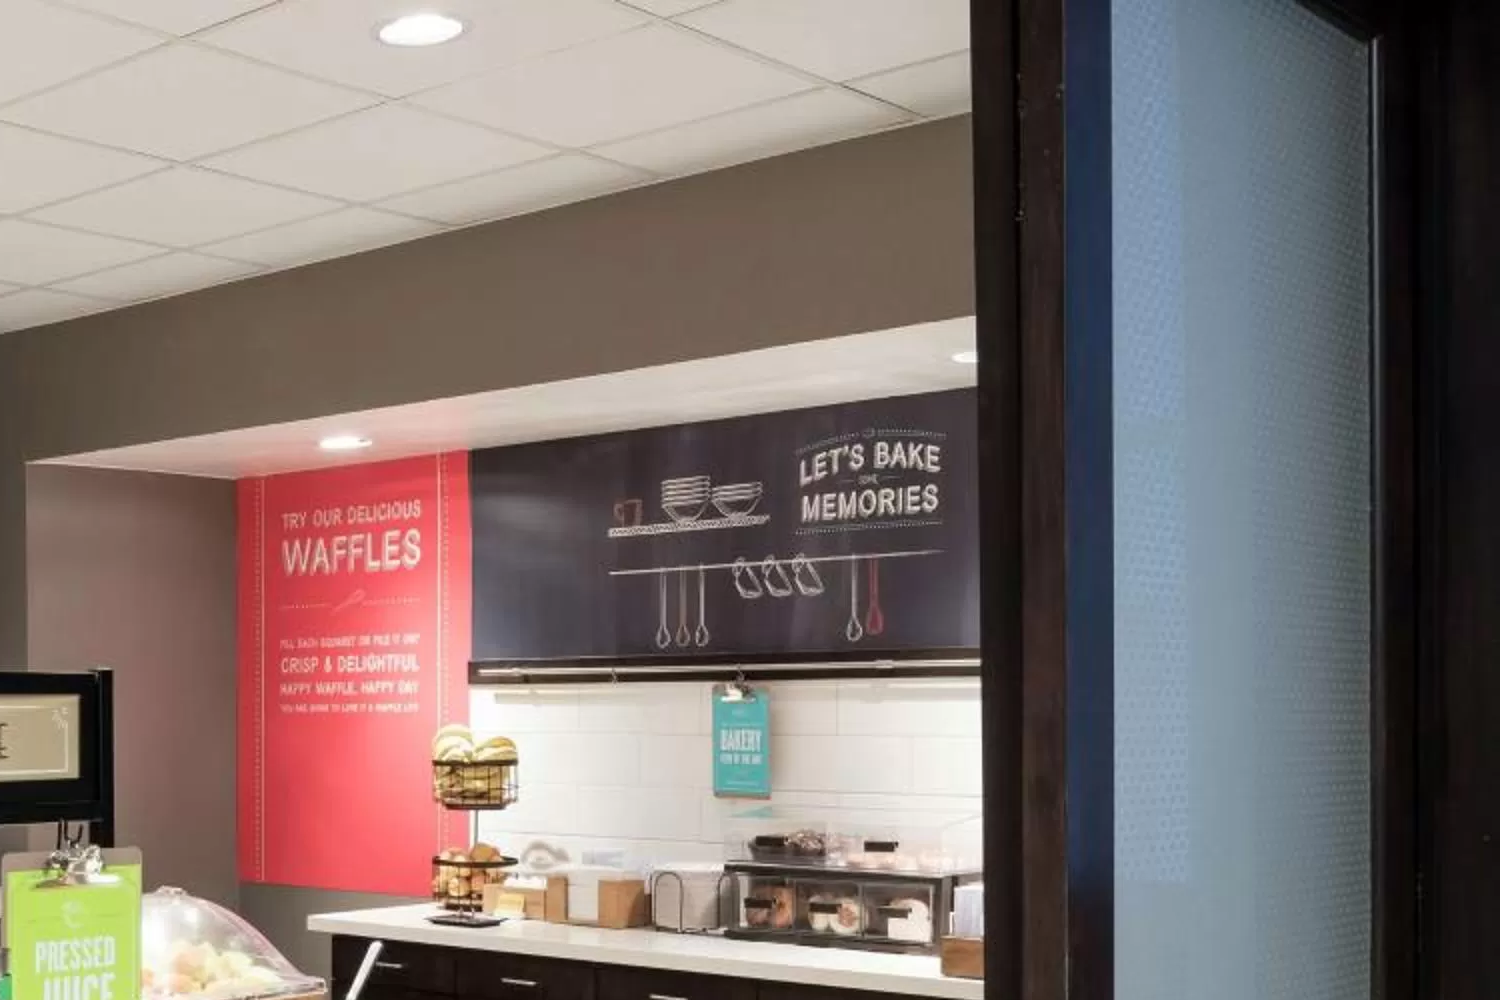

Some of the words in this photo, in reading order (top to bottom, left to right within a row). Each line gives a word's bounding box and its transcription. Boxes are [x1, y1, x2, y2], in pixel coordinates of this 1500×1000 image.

[800, 443, 865, 487] LET'S
[874, 441, 941, 473] BAKE
[282, 512, 307, 531] TRY
[313, 507, 342, 528] OUR
[347, 499, 421, 525] DELICIOUS
[801, 483, 940, 523] MEMORIES
[281, 528, 421, 577] WAFFLES
[280, 656, 319, 673] CRISP
[324, 656, 333, 673] &
[337, 653, 420, 673] DELIGHTFUL
[280, 682, 311, 696] HAPPY
[361, 681, 393, 694] HAPPY
[720, 729, 762, 752] BAKERY
[35, 936, 116, 973] PRESSED
